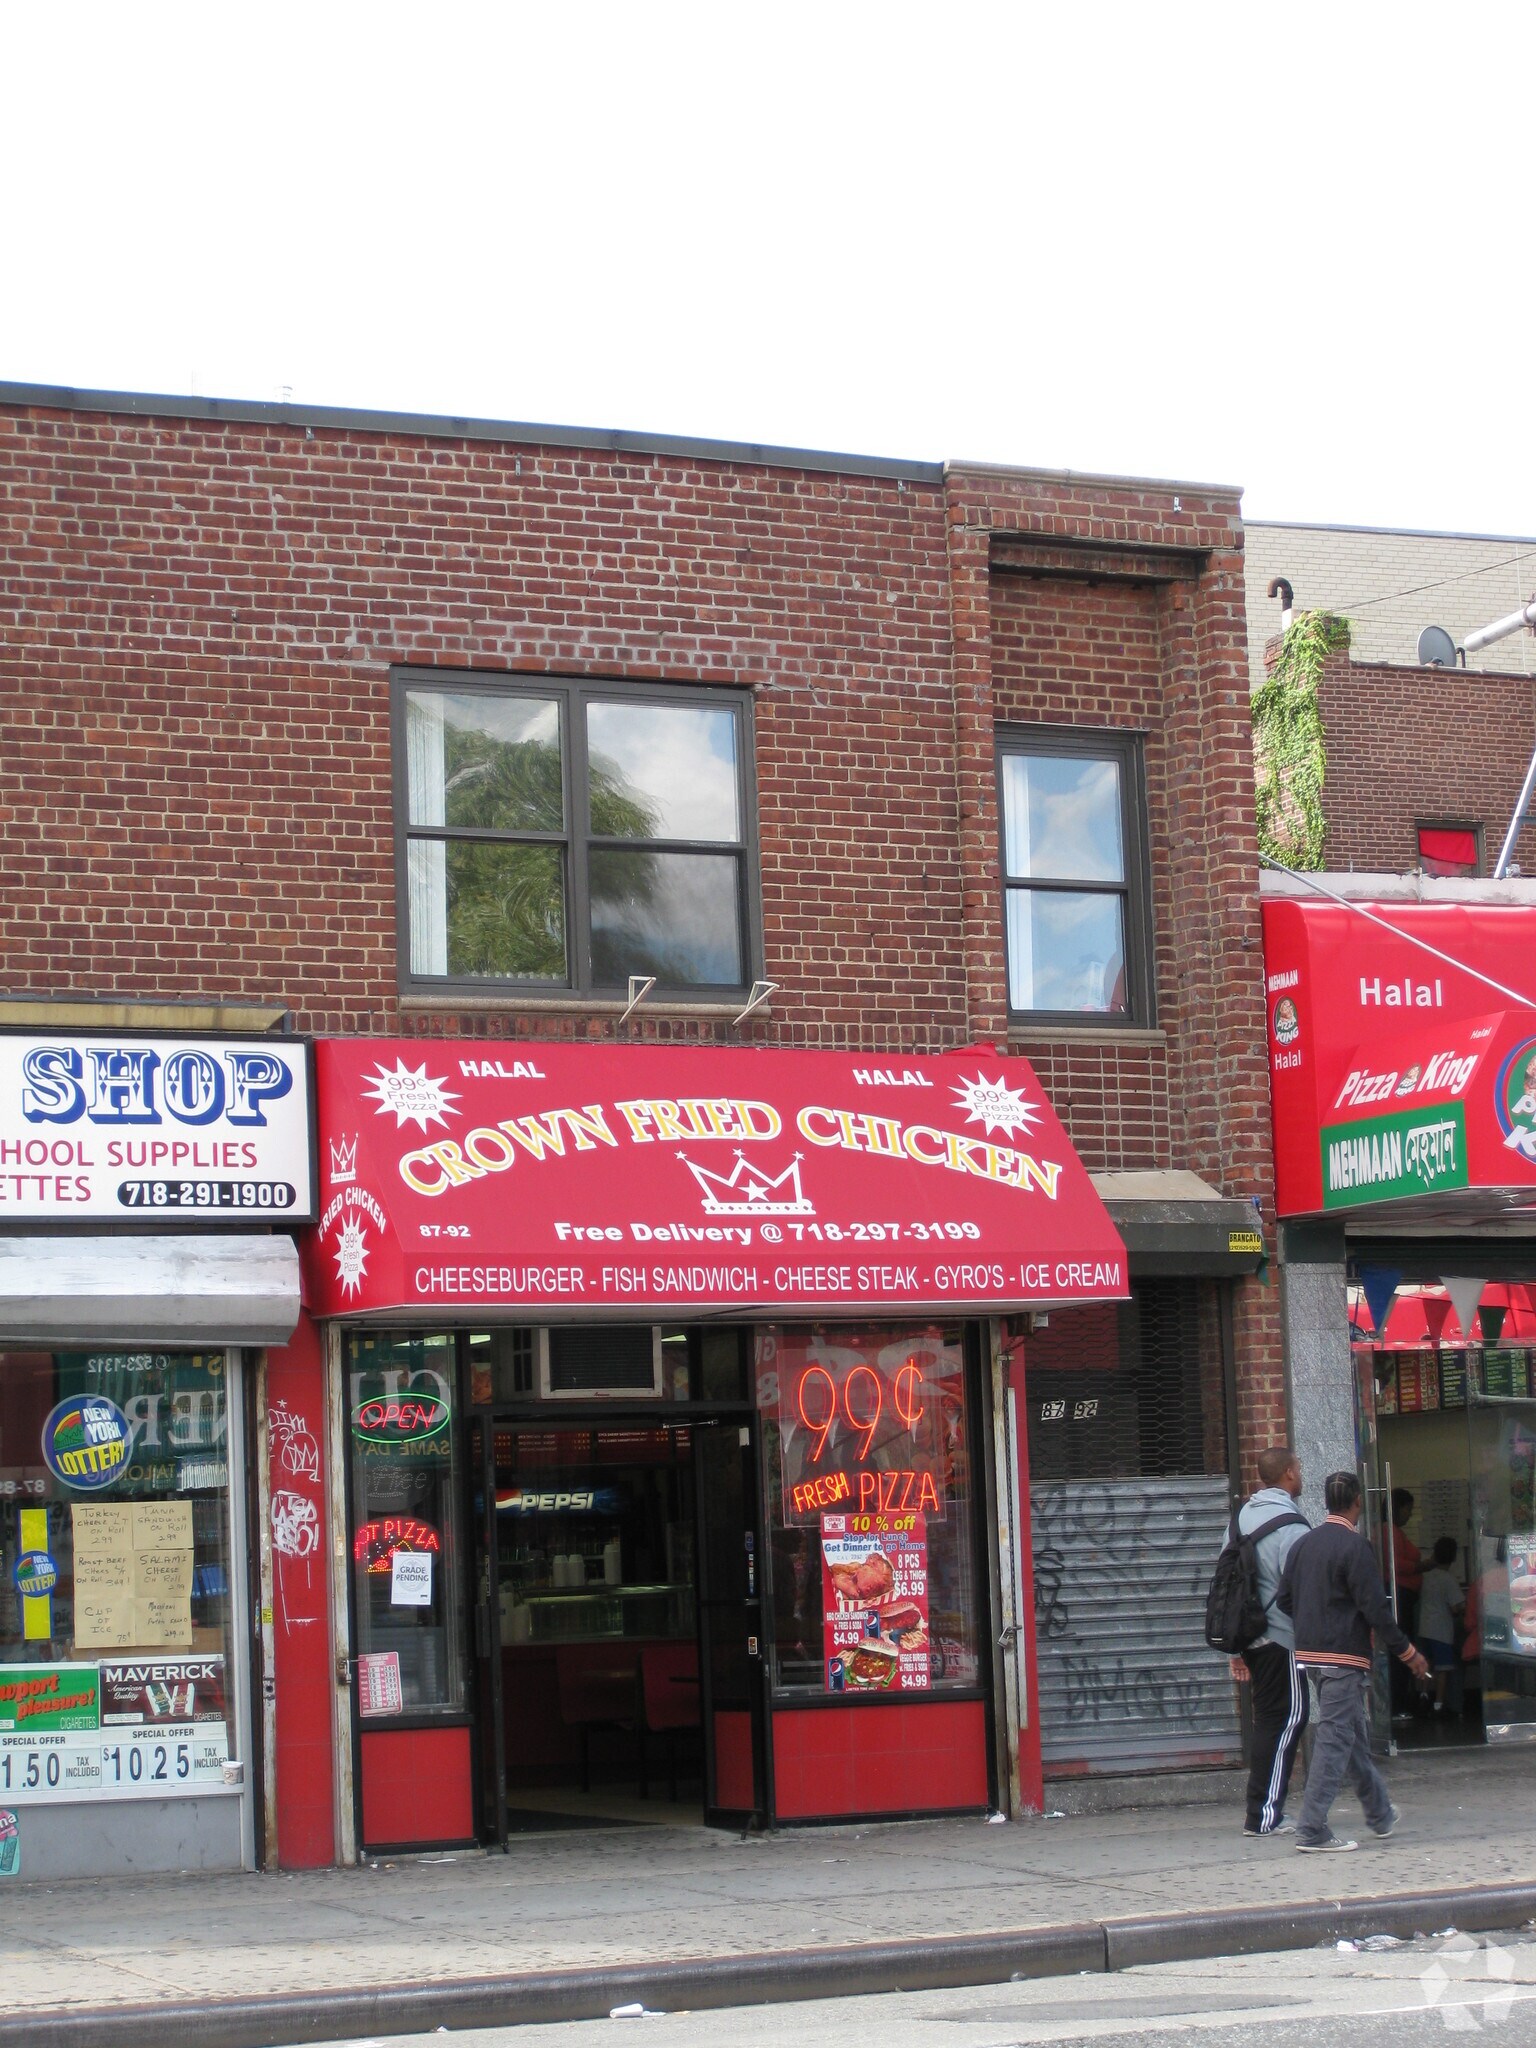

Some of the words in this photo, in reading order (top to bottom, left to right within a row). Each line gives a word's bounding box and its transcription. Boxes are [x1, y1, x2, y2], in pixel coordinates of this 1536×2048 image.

[1268, 969, 1298, 992] MEHMAAN
[1360, 978, 1442, 1007] Halal
[1276, 1026, 1299, 1043] KING
[1274, 1049, 1301, 1070] Halal
[459, 1061, 546, 1078] HALAL
[852, 1069, 934, 1086] HALAL
[1334, 1069, 1398, 1108] Pizza
[1417, 1051, 1478, 1095] King
[22, 1046, 293, 1127] SHOP
[387, 1091, 437, 1100] Fresh
[394, 1101, 438, 1111] Pizza
[973, 1102, 1019, 1112] Fresh
[981, 1111, 1020, 1121] Pizza
[107, 1142, 258, 1168] SUPPLIES
[399, 1104, 619, 1197] CROWN
[614, 1099, 783, 1143] FRIED
[796, 1106, 1063, 1201] CHICKEN
[1329, 1131, 1402, 1191] MEHMAAN
[125, 1182, 288, 1207] 718-291-1900
[318, 1193, 343, 1243] FRIED
[346, 1187, 387, 1235] CHICKEN
[419, 1225, 471, 1237] 87-92
[554, 1223, 623, 1241] Free
[630, 1223, 751, 1246] Delivery
[760, 1223, 784, 1243] @
[787, 1222, 981, 1241] 718-297-3199
[1229, 1233, 1261, 1243] BRANCATO
[344, 1250, 360, 1260] Fresh
[345, 1262, 358, 1273] Pizza
[415, 1267, 585, 1293] CHEESEBURGER
[602, 1267, 646, 1291] FISH
[652, 1266, 758, 1292] SANDWICH
[774, 1266, 852, 1291] CHEESE
[857, 1266, 919, 1290] STEAK
[934, 1264, 1004, 1289] GYRO'S
[1020, 1264, 1051, 1288] ICE
[1055, 1263, 1120, 1287] CREAM
[83, 1407, 111, 1422] NEW
[360, 1404, 436, 1429] OPEN
[798, 1358, 924, 1462] 99¢
[1043, 1401, 1064, 1418] 87
[1076, 1401, 1096, 1418] 92
[86, 1421, 122, 1443] YORK
[56, 1439, 126, 1477] LOTTERY
[793, 1472, 850, 1512] FRESH
[859, 1472, 939, 1512] PIZZA
[521, 1493, 593, 1511] PEPSI
[852, 1516, 870, 1531] 10
[876, 1516, 889, 1531] %
[894, 1515, 916, 1530] off
[385, 1520, 439, 1550] PIZZA
[843, 1532, 864, 1543] Stop
[866, 1532, 879, 1541] for
[881, 1532, 908, 1541] Lunch
[825, 1543, 840, 1552] Get
[843, 1542, 872, 1551] Dinner
[874, 1543, 883, 1551] to
[886, 1545, 896, 1553] go
[900, 1540, 925, 1550] Home
[33, 1555, 49, 1563] NEW
[898, 1554, 903, 1568] 8
[905, 1553, 920, 1568] PCS
[35, 1563, 55, 1575] YORK
[400, 1566, 427, 1574] GRADE
[892, 1571, 903, 1580] LEG
[909, 1570, 926, 1580] THIGH
[18, 1573, 56, 1592] LOTTERY
[894, 1582, 925, 1596] $6.99
[833, 1632, 859, 1646] $4.99
[105, 1664, 216, 1683] MAVERICK
[901, 1674, 928, 1688] $4.99
[108, 1685, 144, 1693] American
[16, 1688, 95, 1721] pleasure!
[113, 1692, 139, 1702] Quality
[60, 1717, 97, 1729] CIGARETTES
[193, 1711, 222, 1722] CIGARETTES
[2, 1737, 37, 1746] SPECIAL
[39, 1736, 66, 1745] OFFER
[132, 1730, 166, 1739] SPECIAL
[169, 1728, 194, 1737] OFFER
[204, 1747, 217, 1757] TAX
[76, 1756, 89, 1766] TAX
[65, 1765, 100, 1778] INCLUDED
